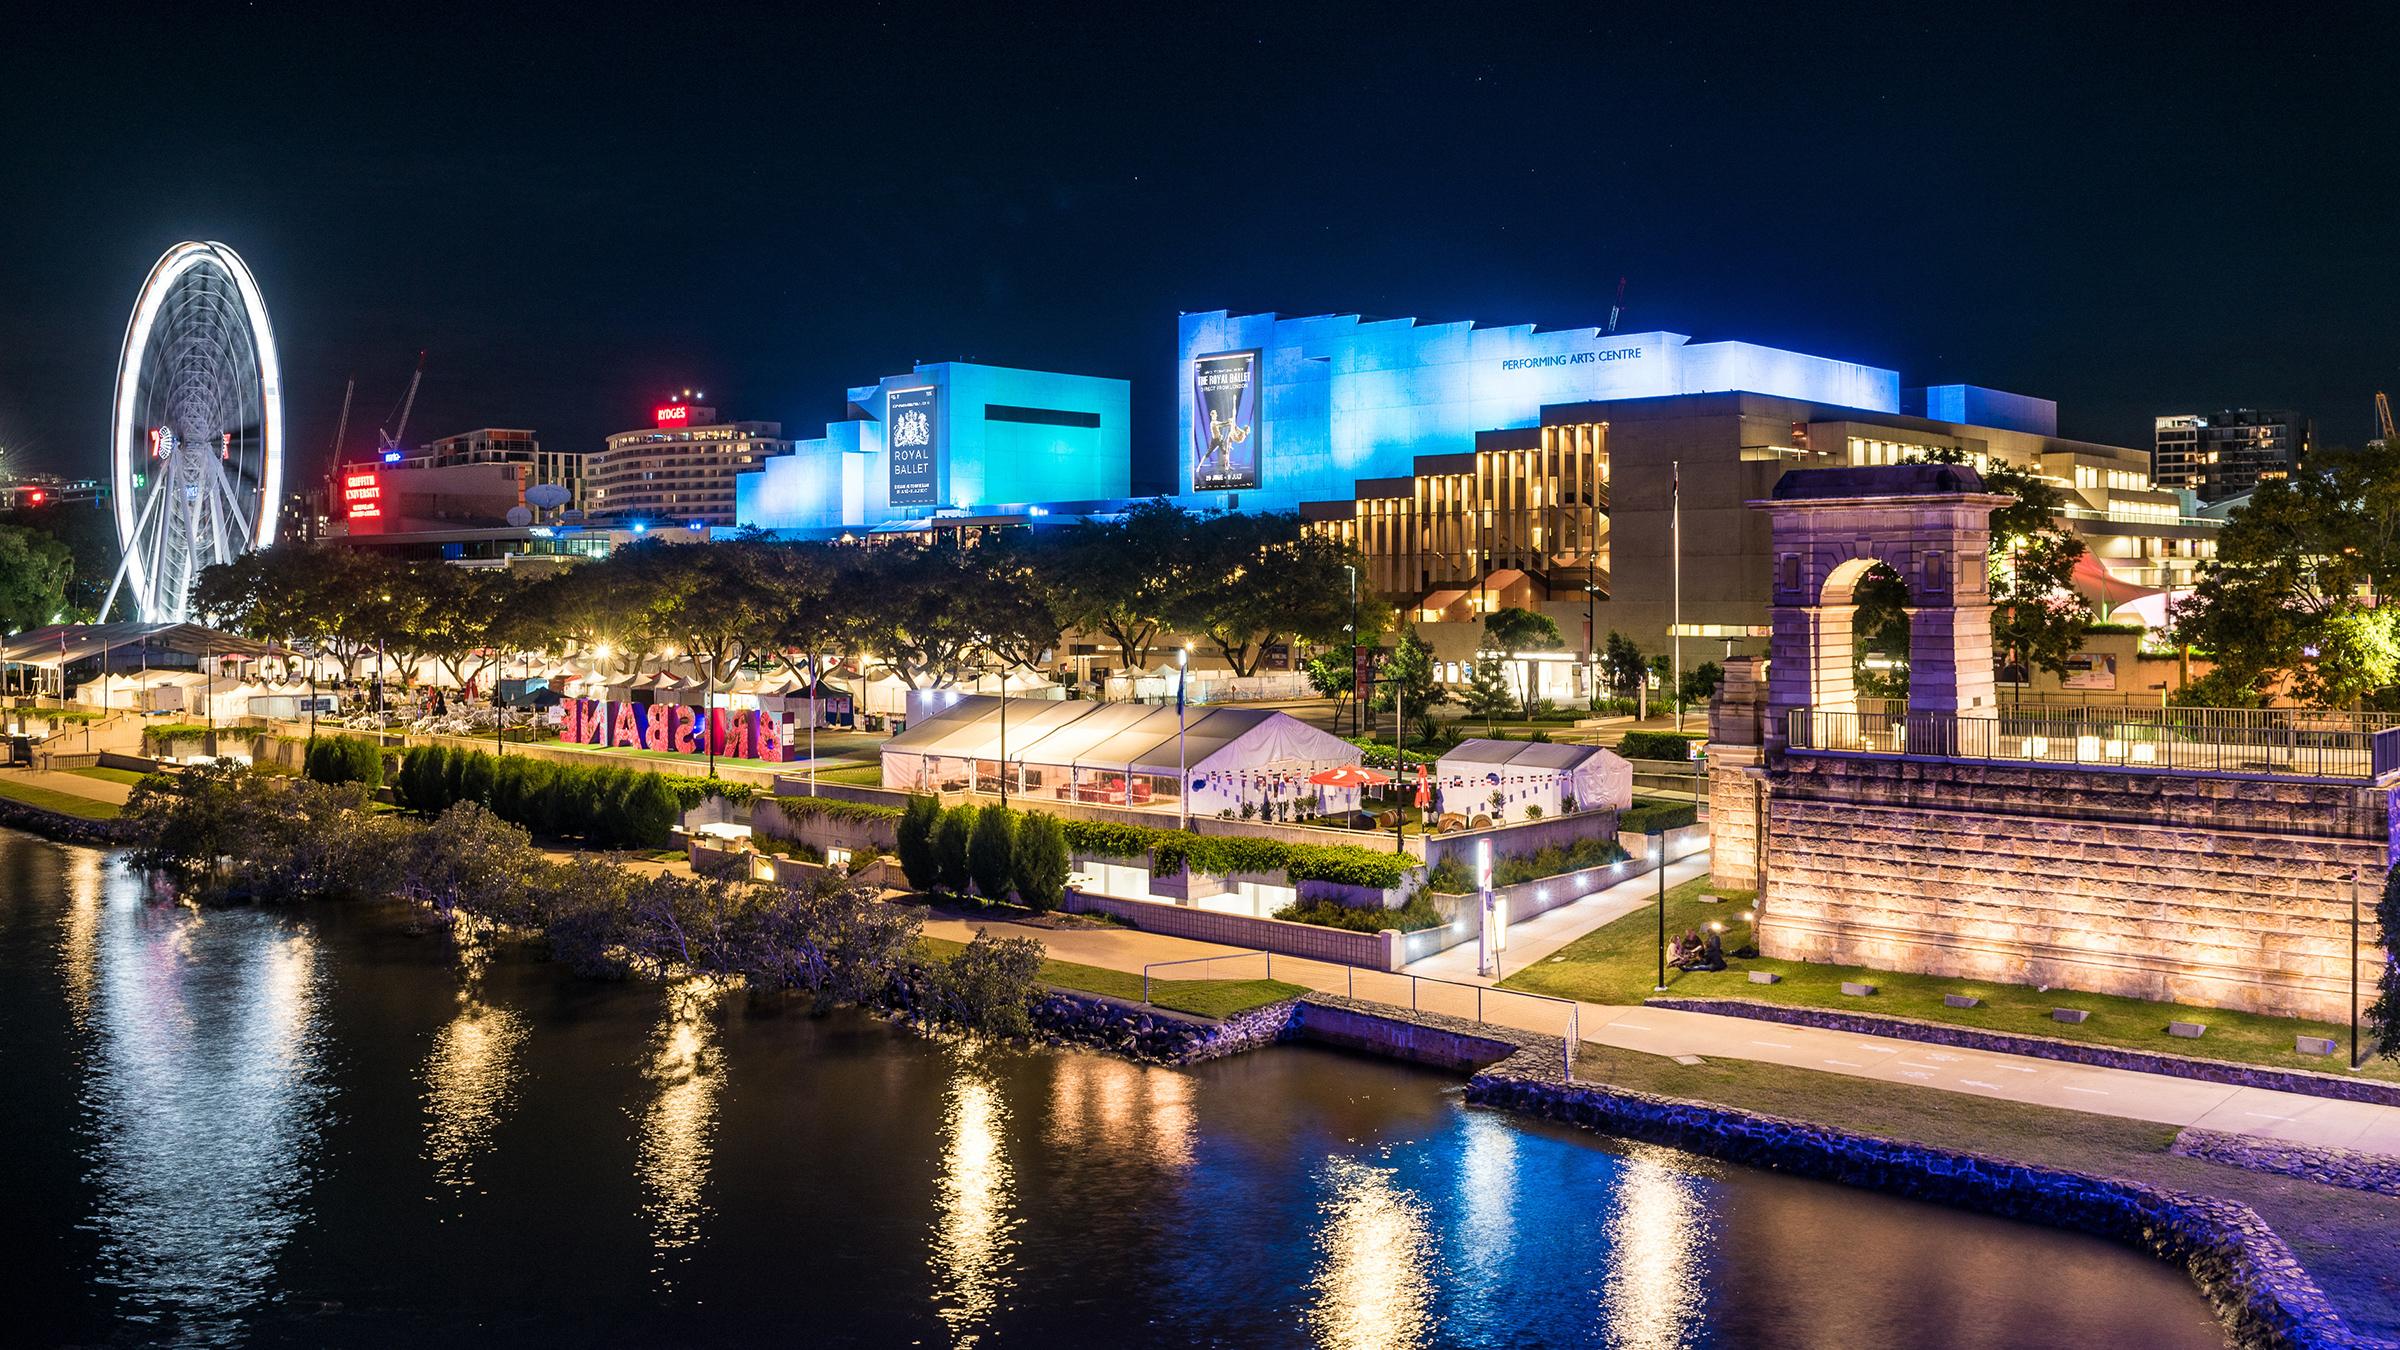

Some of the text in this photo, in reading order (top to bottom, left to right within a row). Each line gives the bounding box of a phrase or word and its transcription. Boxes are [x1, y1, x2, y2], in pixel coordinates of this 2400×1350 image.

[1502, 347, 1642, 371] PERFORMING ARTS CENTRE
[1198, 371, 1251, 386] THE ROYAL BALLET
[658, 406, 686, 421] RYDGES
[894, 449, 929, 461] ROYAL
[894, 463, 929, 475] BALLET
[347, 475, 375, 488] GRIFFITH
[345, 487, 380, 501] UNIVERSITY
